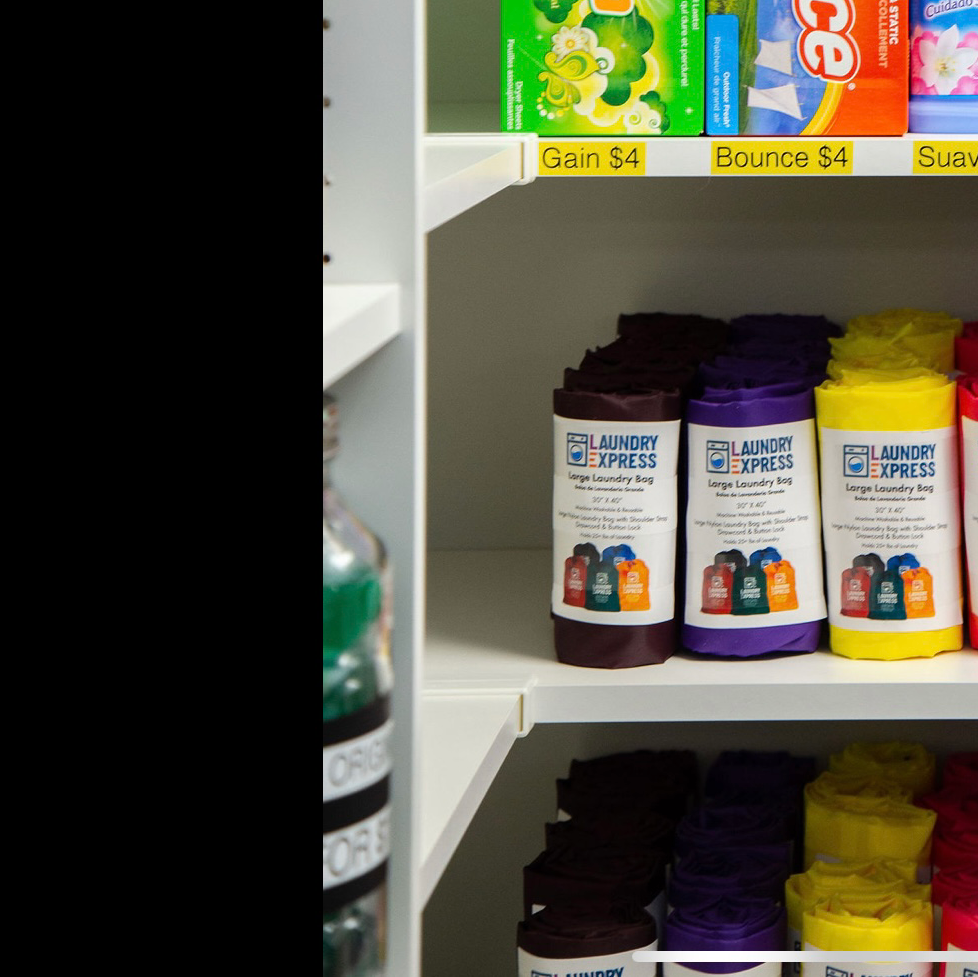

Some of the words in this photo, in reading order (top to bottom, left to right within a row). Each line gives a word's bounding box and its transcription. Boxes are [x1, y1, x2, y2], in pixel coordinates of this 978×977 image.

[680, 1, 688, 14] qui
[889, 5, 899, 45] STATIC
[682, 38, 688, 47] et
[879, 0, 887, 68] COLLEMENT
[507, 39, 515, 68] Feuilles
[714, 75, 720, 85] de
[515, 81, 523, 103] Dryer
[515, 105, 523, 130] Sheets
[542, 147, 600, 169] Gain
[609, 145, 640, 170] $4
[717, 146, 808, 168] Bounce
[818, 145, 848, 169] $4
[590, 434, 659, 451] LAUNDRY
[732, 436, 794, 456] LAUNDRY
[589, 452, 657, 468] EXPRESS
[871, 444, 936, 461] LAUNDRY
[731, 454, 794, 474] EXPRESS
[871, 462, 935, 479] EXPRESS
[568, 472, 589, 483] Large
[593, 474, 632, 485] Laundry
[636, 475, 654, 485] Bag
[708, 479, 733, 490] Large
[736, 479, 775, 490] Laundry
[777, 477, 793, 486] Bag
[846, 483, 872, 494] Large
[875, 483, 915, 494] Laundry
[917, 483, 934, 493] Bag
